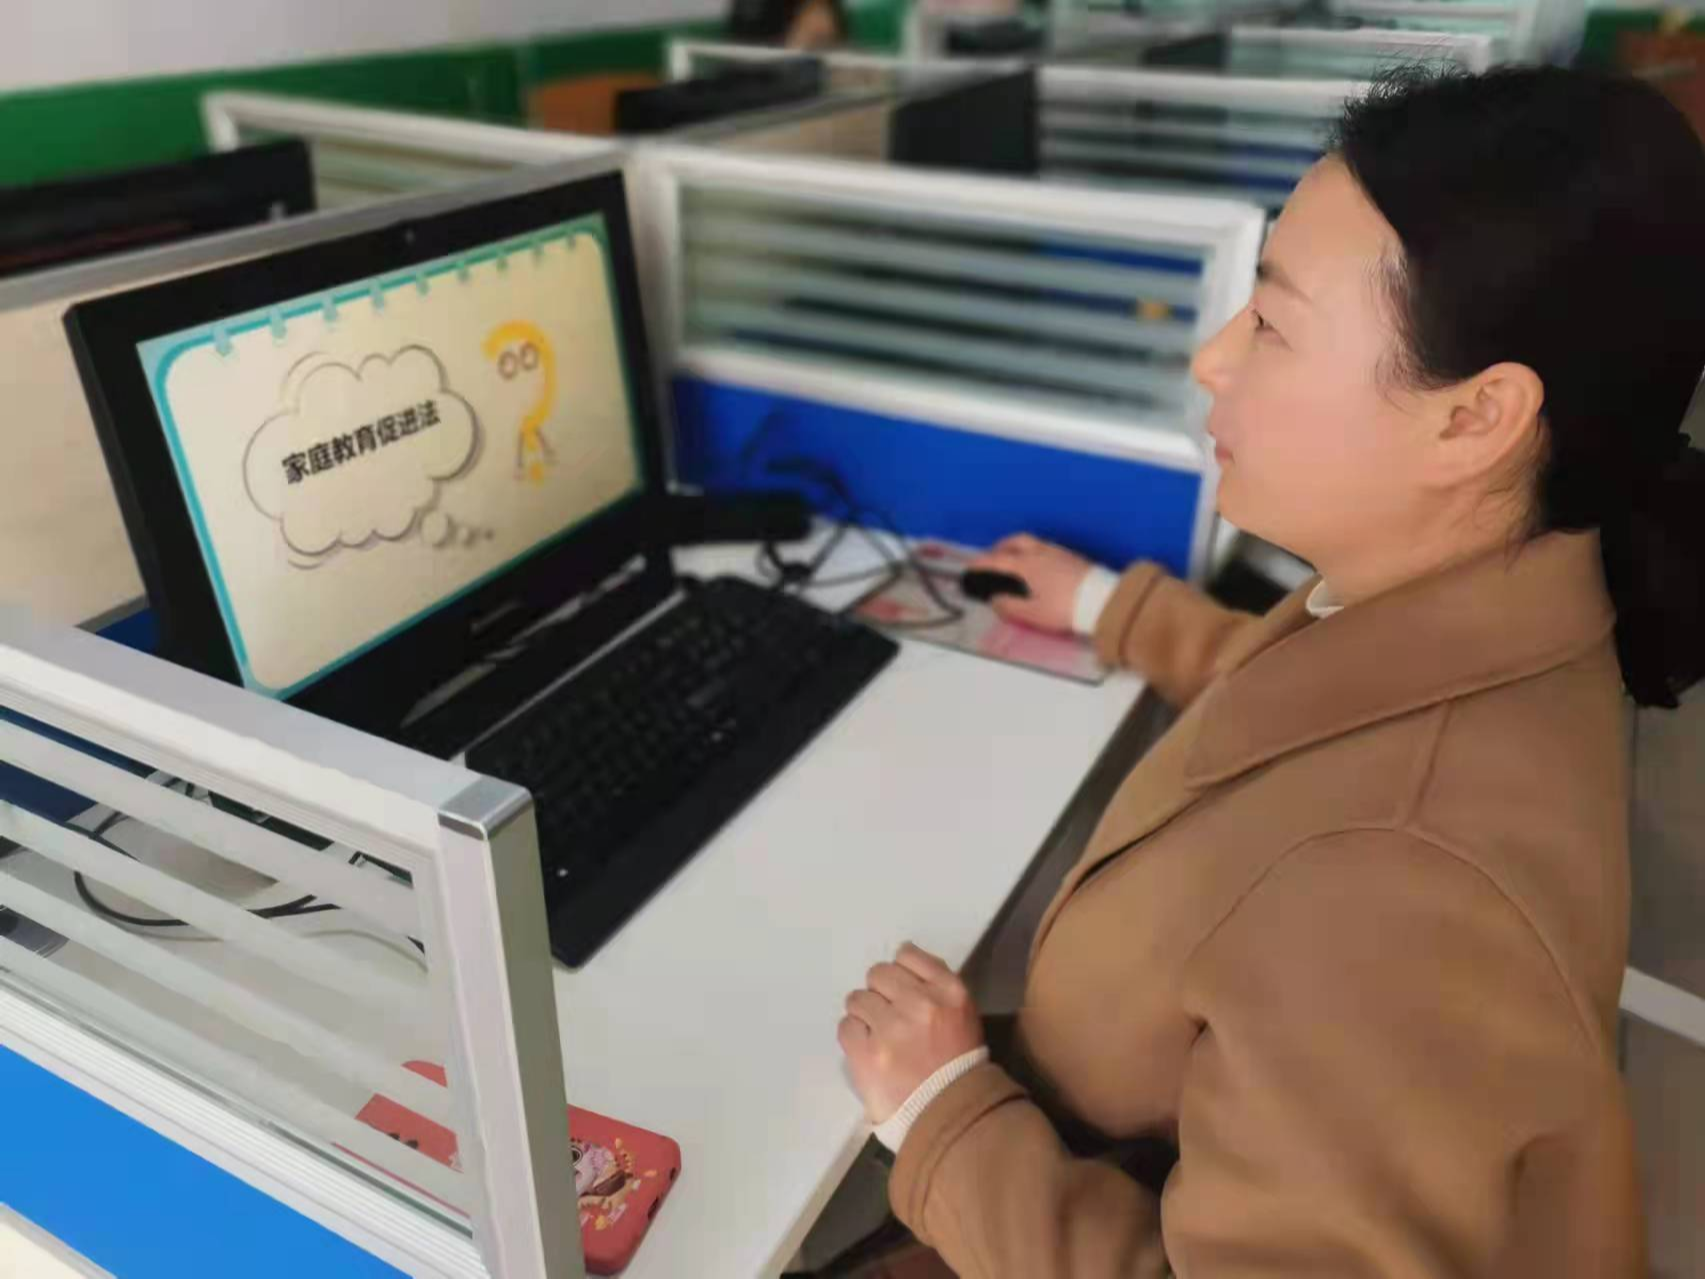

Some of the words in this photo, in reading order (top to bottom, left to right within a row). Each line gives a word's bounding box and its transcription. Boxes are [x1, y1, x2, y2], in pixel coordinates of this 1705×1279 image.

[281, 400, 440, 484] 家庭教育促进法
